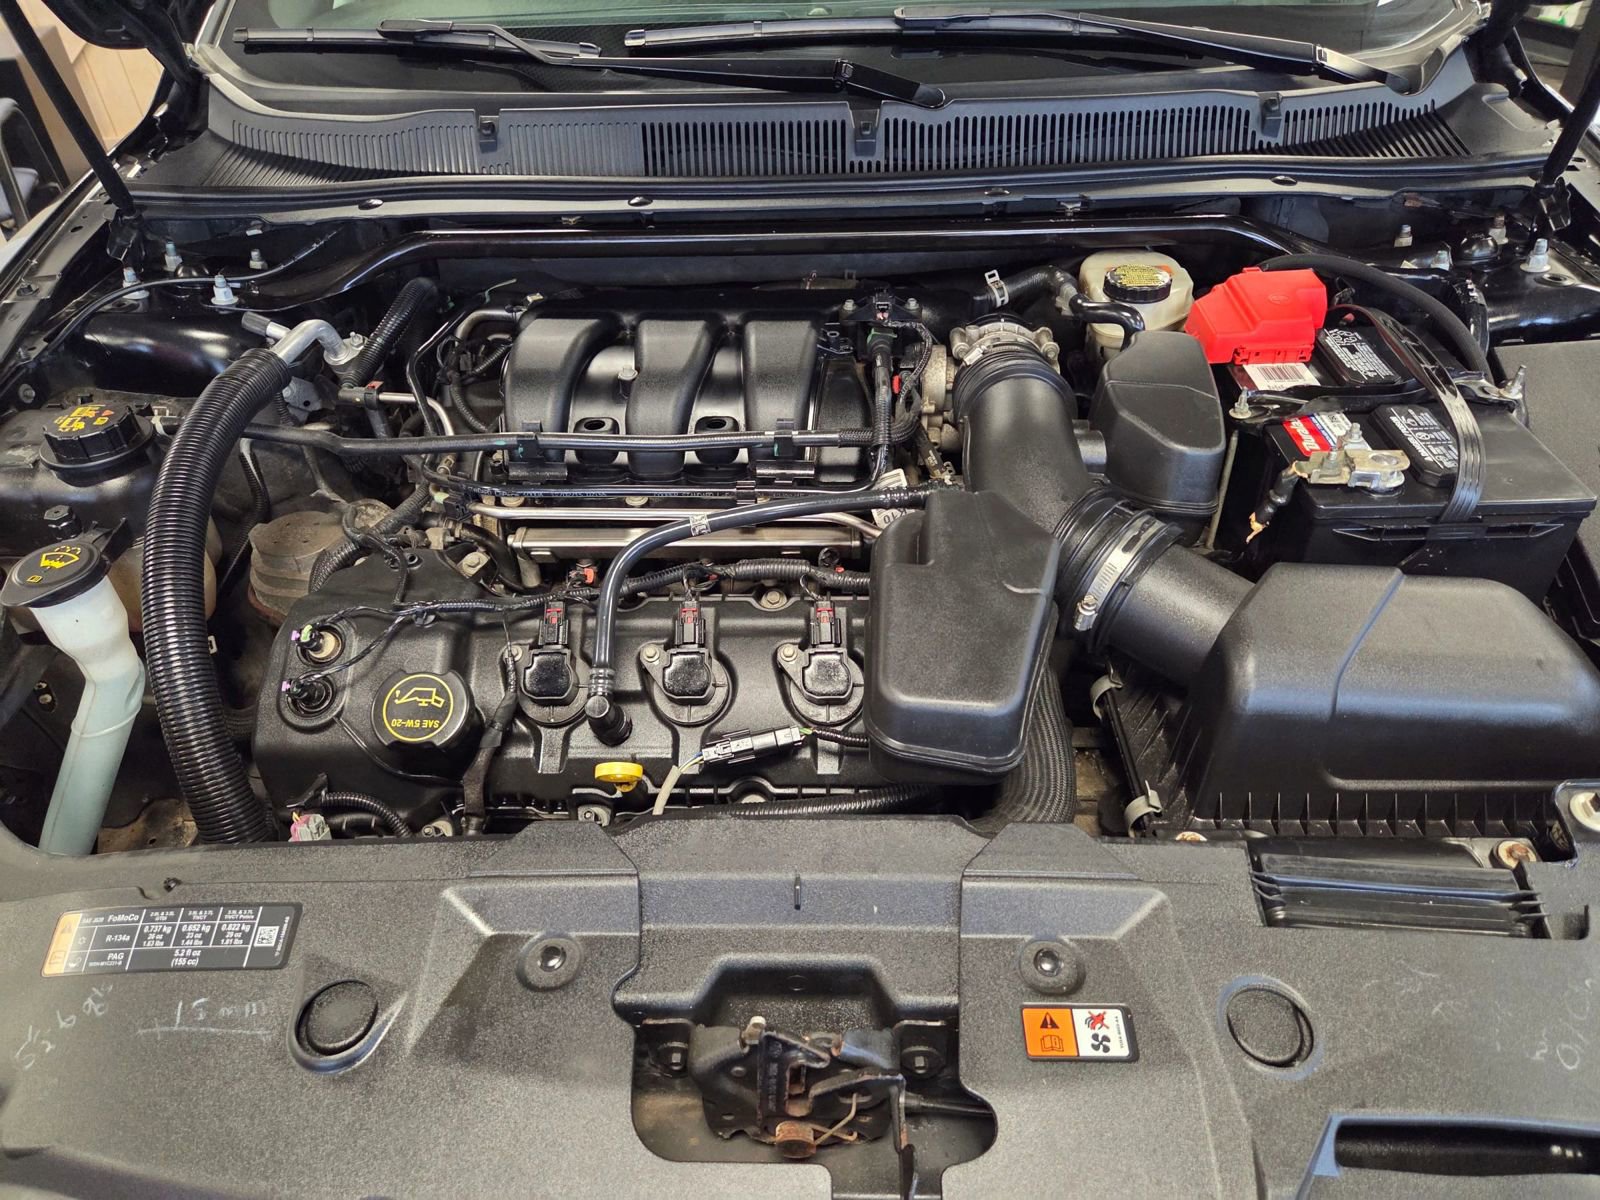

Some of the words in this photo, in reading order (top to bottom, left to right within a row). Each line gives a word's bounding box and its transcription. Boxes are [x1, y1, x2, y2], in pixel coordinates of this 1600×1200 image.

[1289, 417, 1320, 451] Durala
[391, 719, 421, 728] 5W-20
[422, 719, 440, 728] SAE
[107, 914, 139, 922] FoMoCo
[143, 925, 162, 933] 0.737
[162, 925, 172, 934] kg
[181, 924, 200, 932] 0.652
[201, 923, 211, 932] kg
[241, 923, 251, 932] kg
[105, 934, 131, 942] R-134a
[107, 952, 125, 960] PAG
[171, 958, 186, 968] (155
[187, 958, 199, 967] cc)
